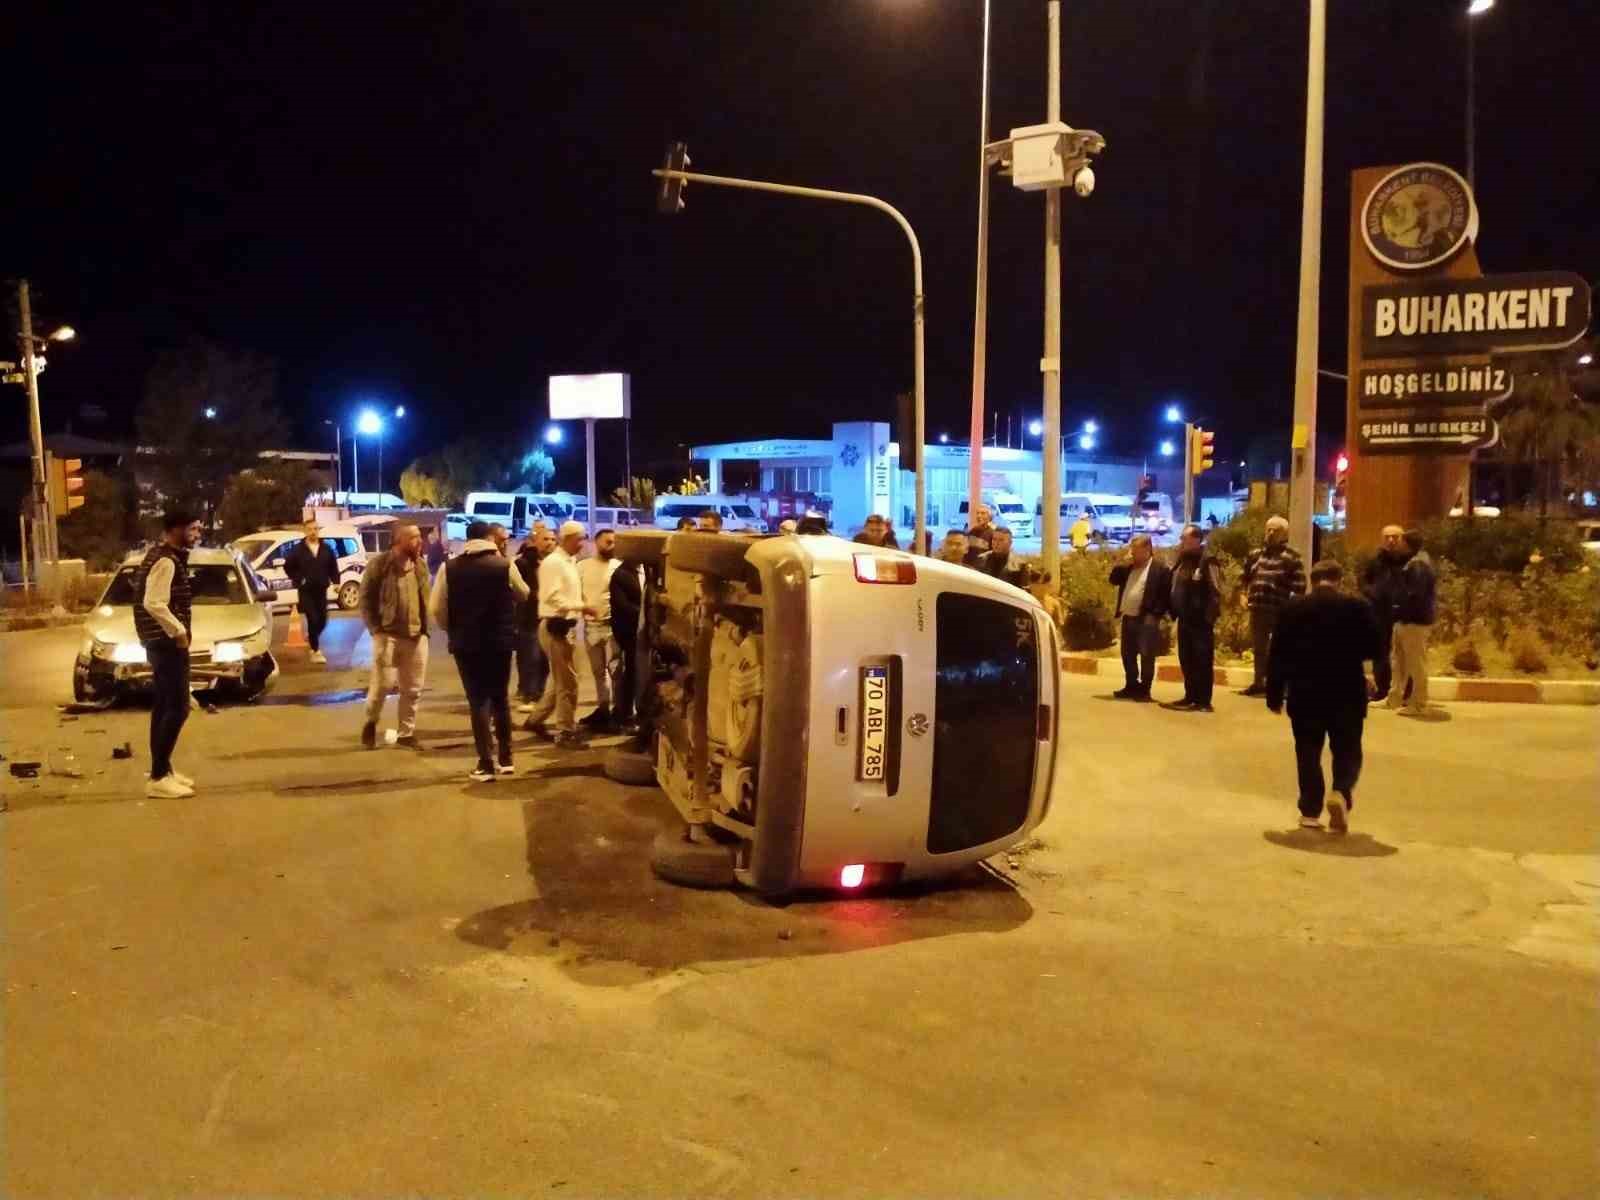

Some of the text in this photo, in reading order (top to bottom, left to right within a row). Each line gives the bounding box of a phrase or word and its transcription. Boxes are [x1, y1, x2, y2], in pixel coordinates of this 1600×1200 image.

[1375, 286, 1574, 337] BUHARKENT
[1364, 366, 1505, 399] HOŞGELDİNİZ
[1361, 419, 1486, 438] ŞEHİR MERKEZİ
[868, 679, 883, 700] 70
[867, 707, 882, 739] ABL
[865, 743, 881, 777] 785
